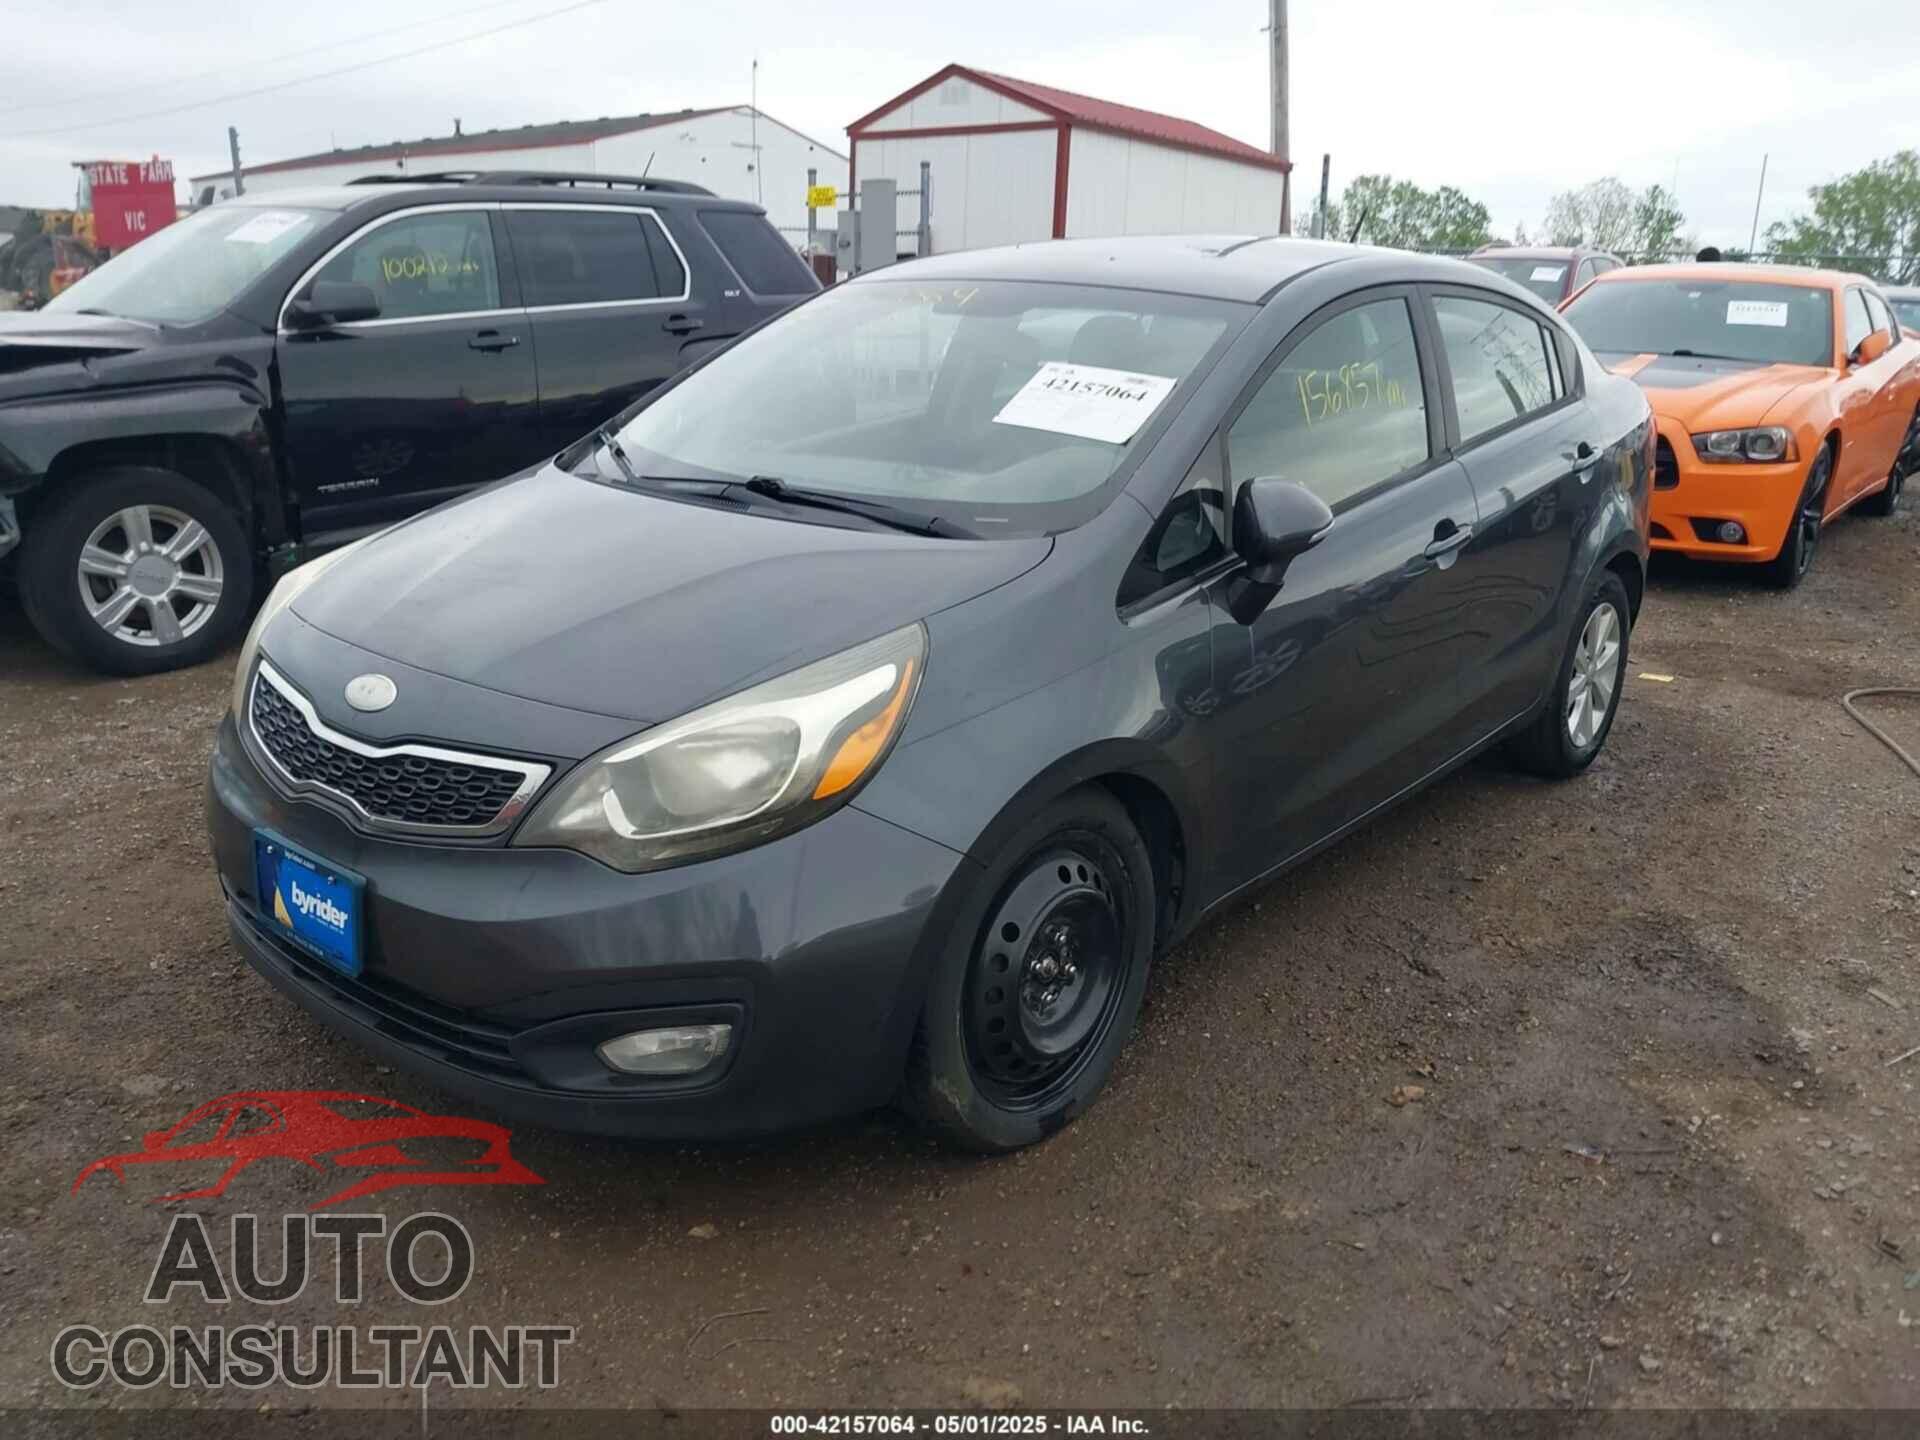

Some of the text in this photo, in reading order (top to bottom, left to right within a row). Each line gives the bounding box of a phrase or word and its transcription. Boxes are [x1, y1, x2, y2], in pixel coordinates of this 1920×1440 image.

[89, 160, 175, 187] STATE FARM
[124, 210, 147, 232] VIC
[1043, 377, 1148, 402] 42157064
[291, 880, 349, 929] byrider
